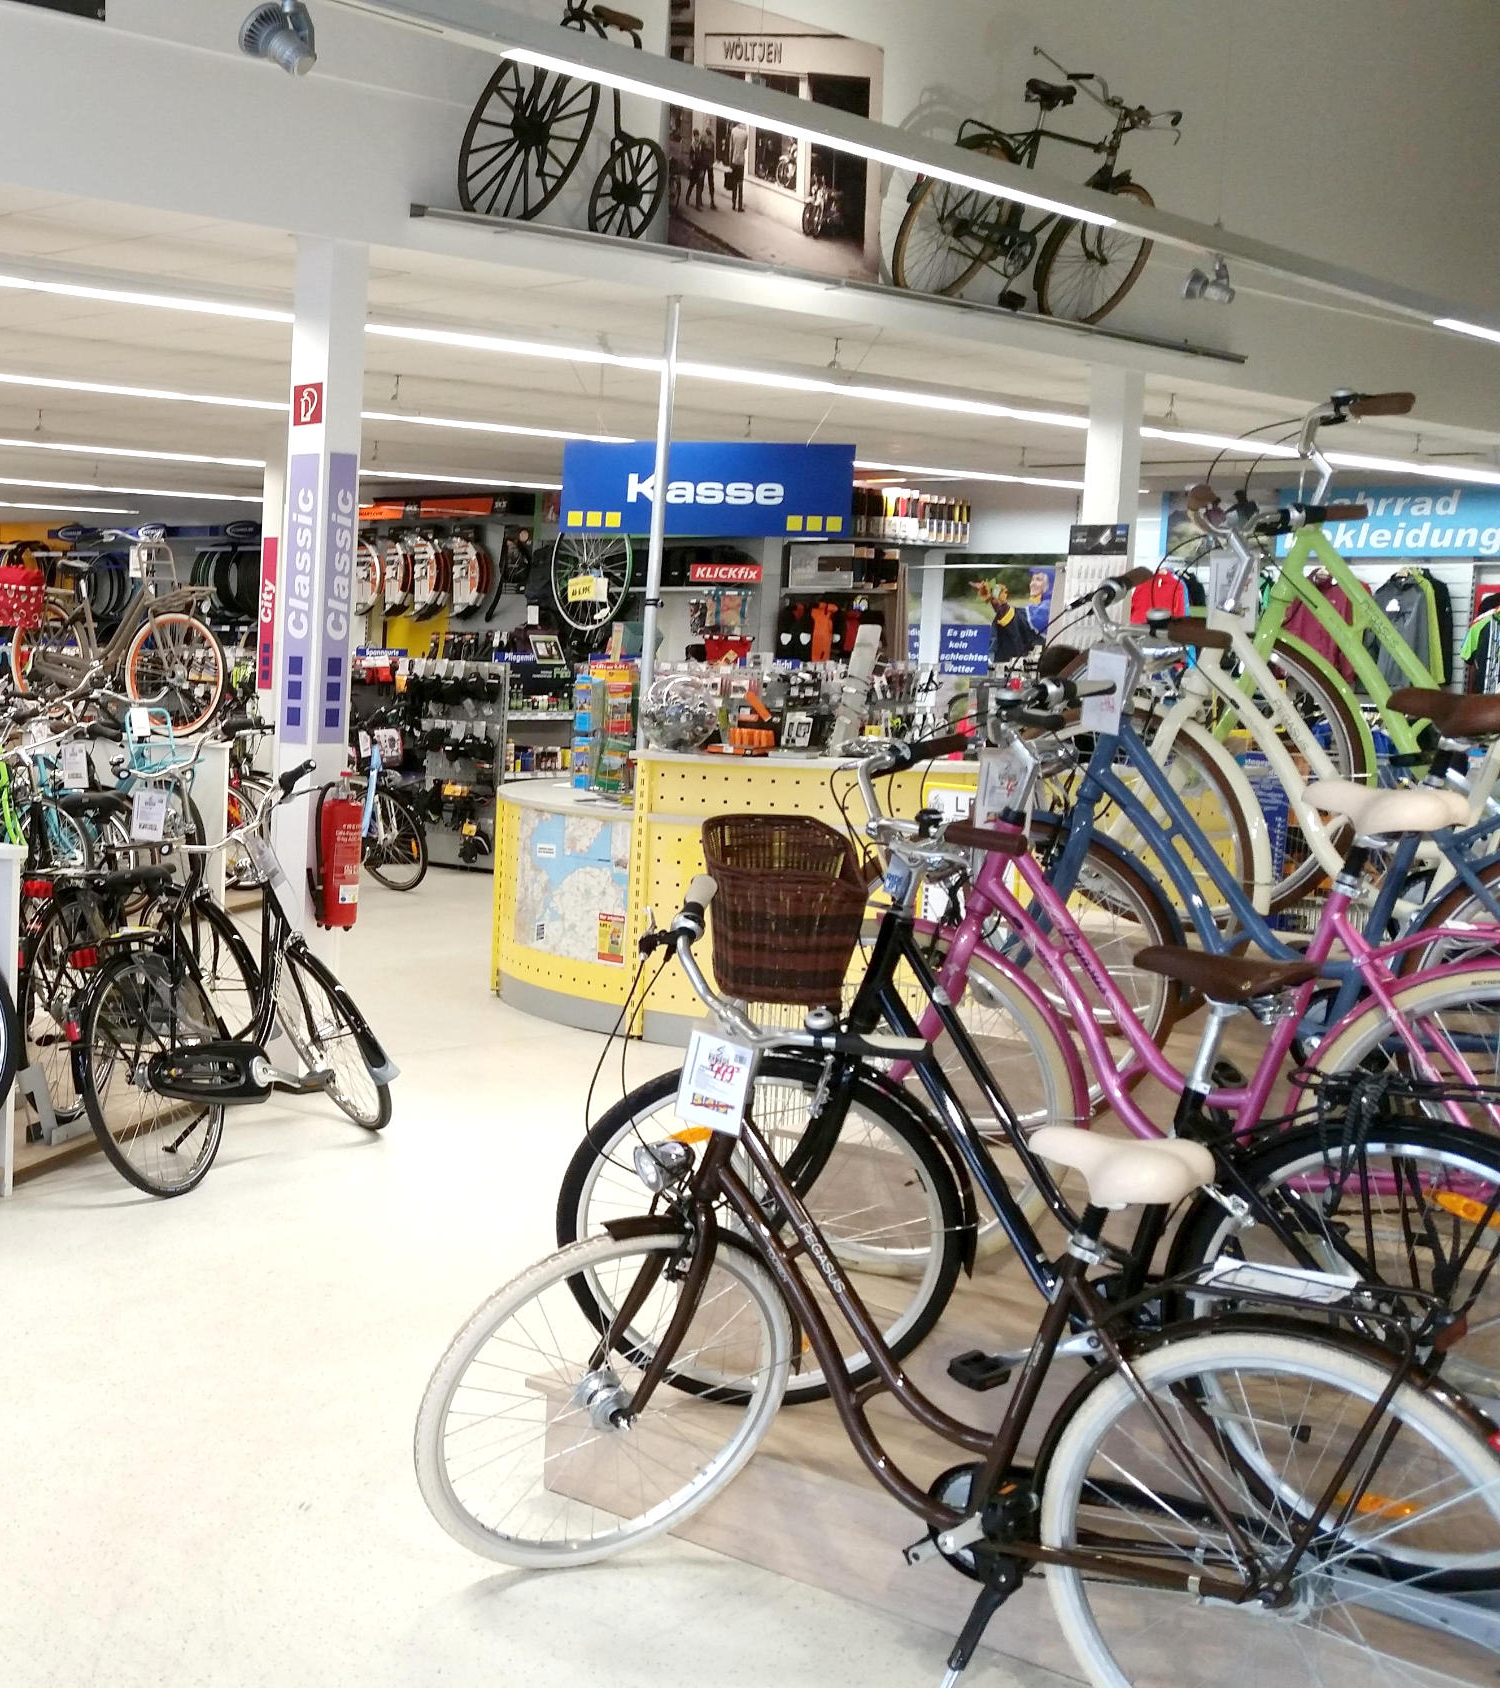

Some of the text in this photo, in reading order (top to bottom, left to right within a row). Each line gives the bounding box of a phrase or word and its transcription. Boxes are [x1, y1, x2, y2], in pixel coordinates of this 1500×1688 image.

[626, 472, 785, 506] Kasse
[1283, 522, 1500, 555] kleidung
[287, 487, 315, 640] Classic
[326, 490, 354, 641] Classic
[695, 567, 758, 580] KLICKfix
[260, 579, 276, 623] City
[947, 628, 978, 639] Es gibt
[948, 640, 969, 649] kein
[940, 652, 988, 662] schlechtes
[944, 663, 976, 674] Wetter
[799, 1222, 846, 1294] PEGASUS
